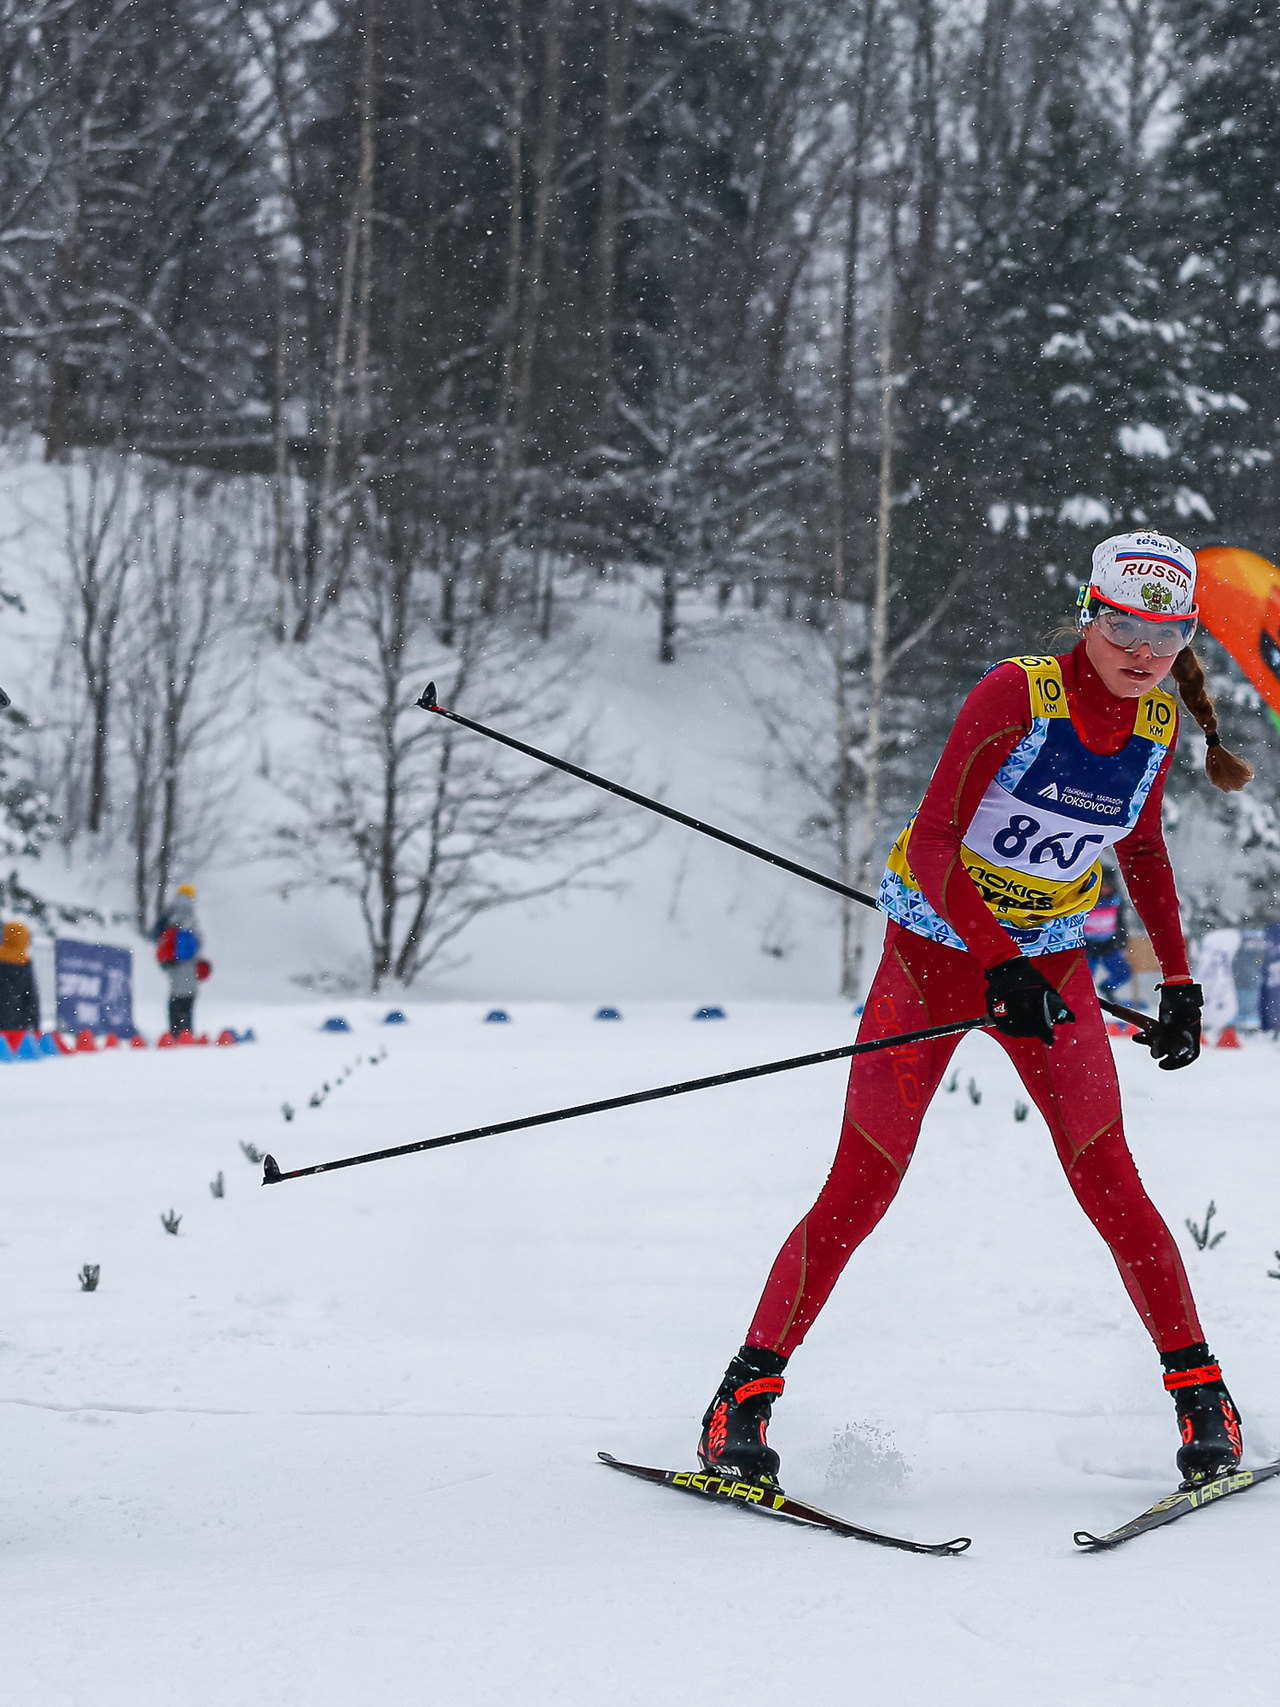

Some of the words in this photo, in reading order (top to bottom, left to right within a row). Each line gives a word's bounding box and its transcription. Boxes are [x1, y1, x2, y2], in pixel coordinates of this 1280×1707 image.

[1136, 538, 1170, 551] team
[1121, 563, 1188, 591] RUSSIA
[1035, 677, 1061, 701] 10
[1144, 699, 1171, 725] 10
[1060, 793, 1121, 815] TOKSOVOCUP
[672, 1473, 764, 1504] FISCHER
[1201, 1471, 1254, 1503] FISCHER
